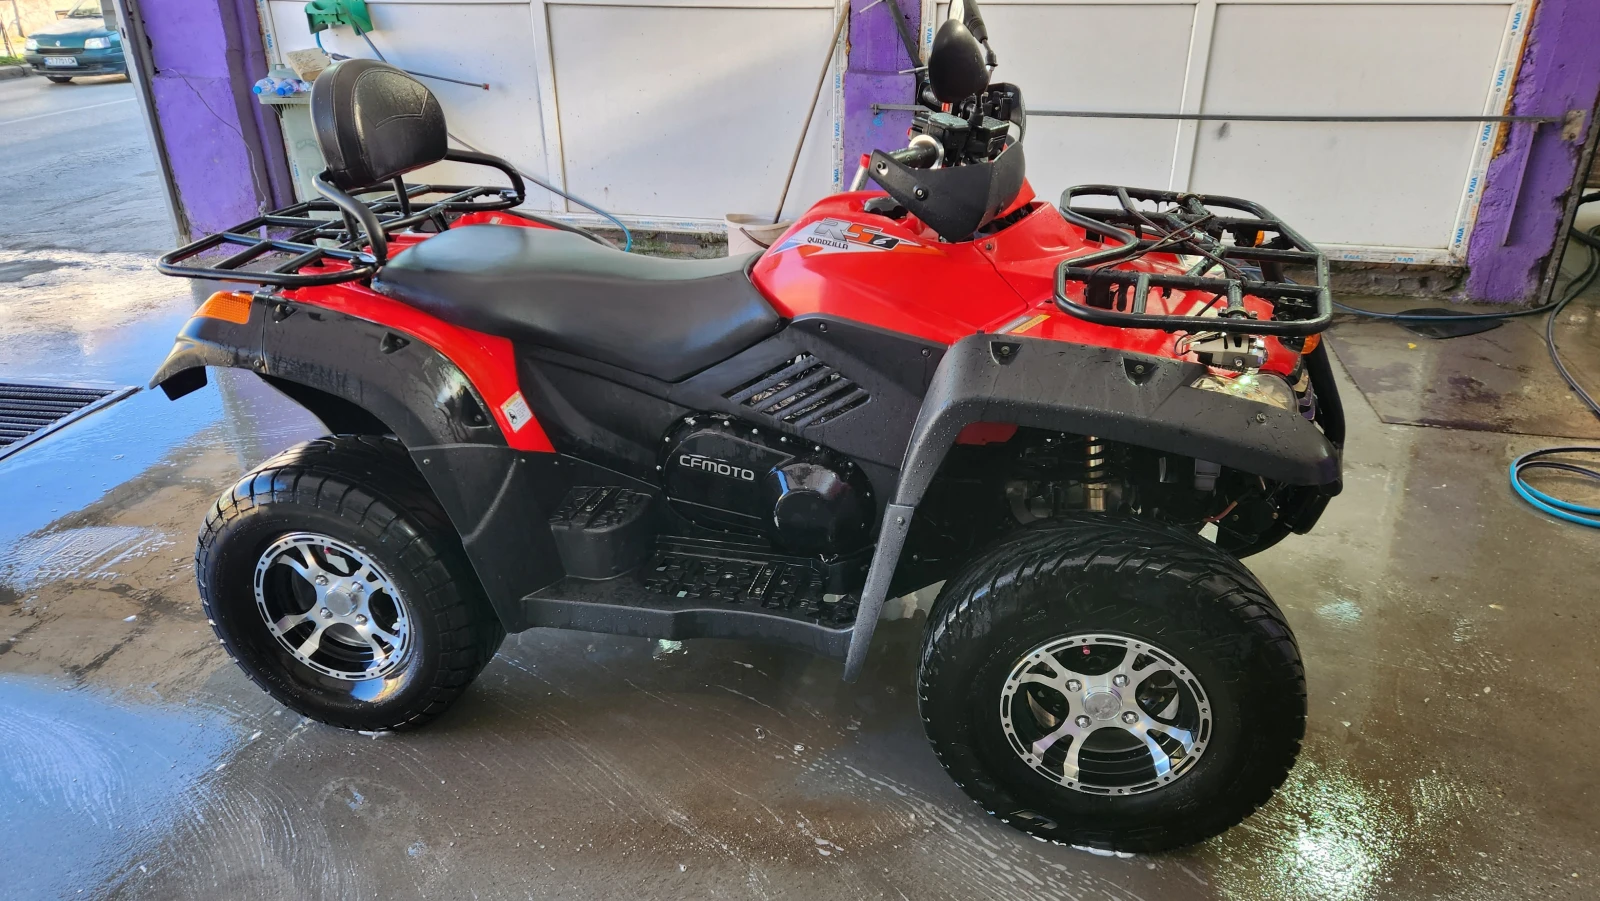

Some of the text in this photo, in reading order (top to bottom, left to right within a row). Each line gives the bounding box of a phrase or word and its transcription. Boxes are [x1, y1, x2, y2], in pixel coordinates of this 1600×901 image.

[1511, 12, 1522, 30] VIVA
[1496, 68, 1506, 87] VIVA
[1481, 124, 1491, 141] VIVA
[1468, 177, 1478, 194] VIVA
[807, 236, 849, 250] QUADZILLA
[1455, 227, 1465, 244] VIVA
[680, 455, 755, 481] CFMOTO
